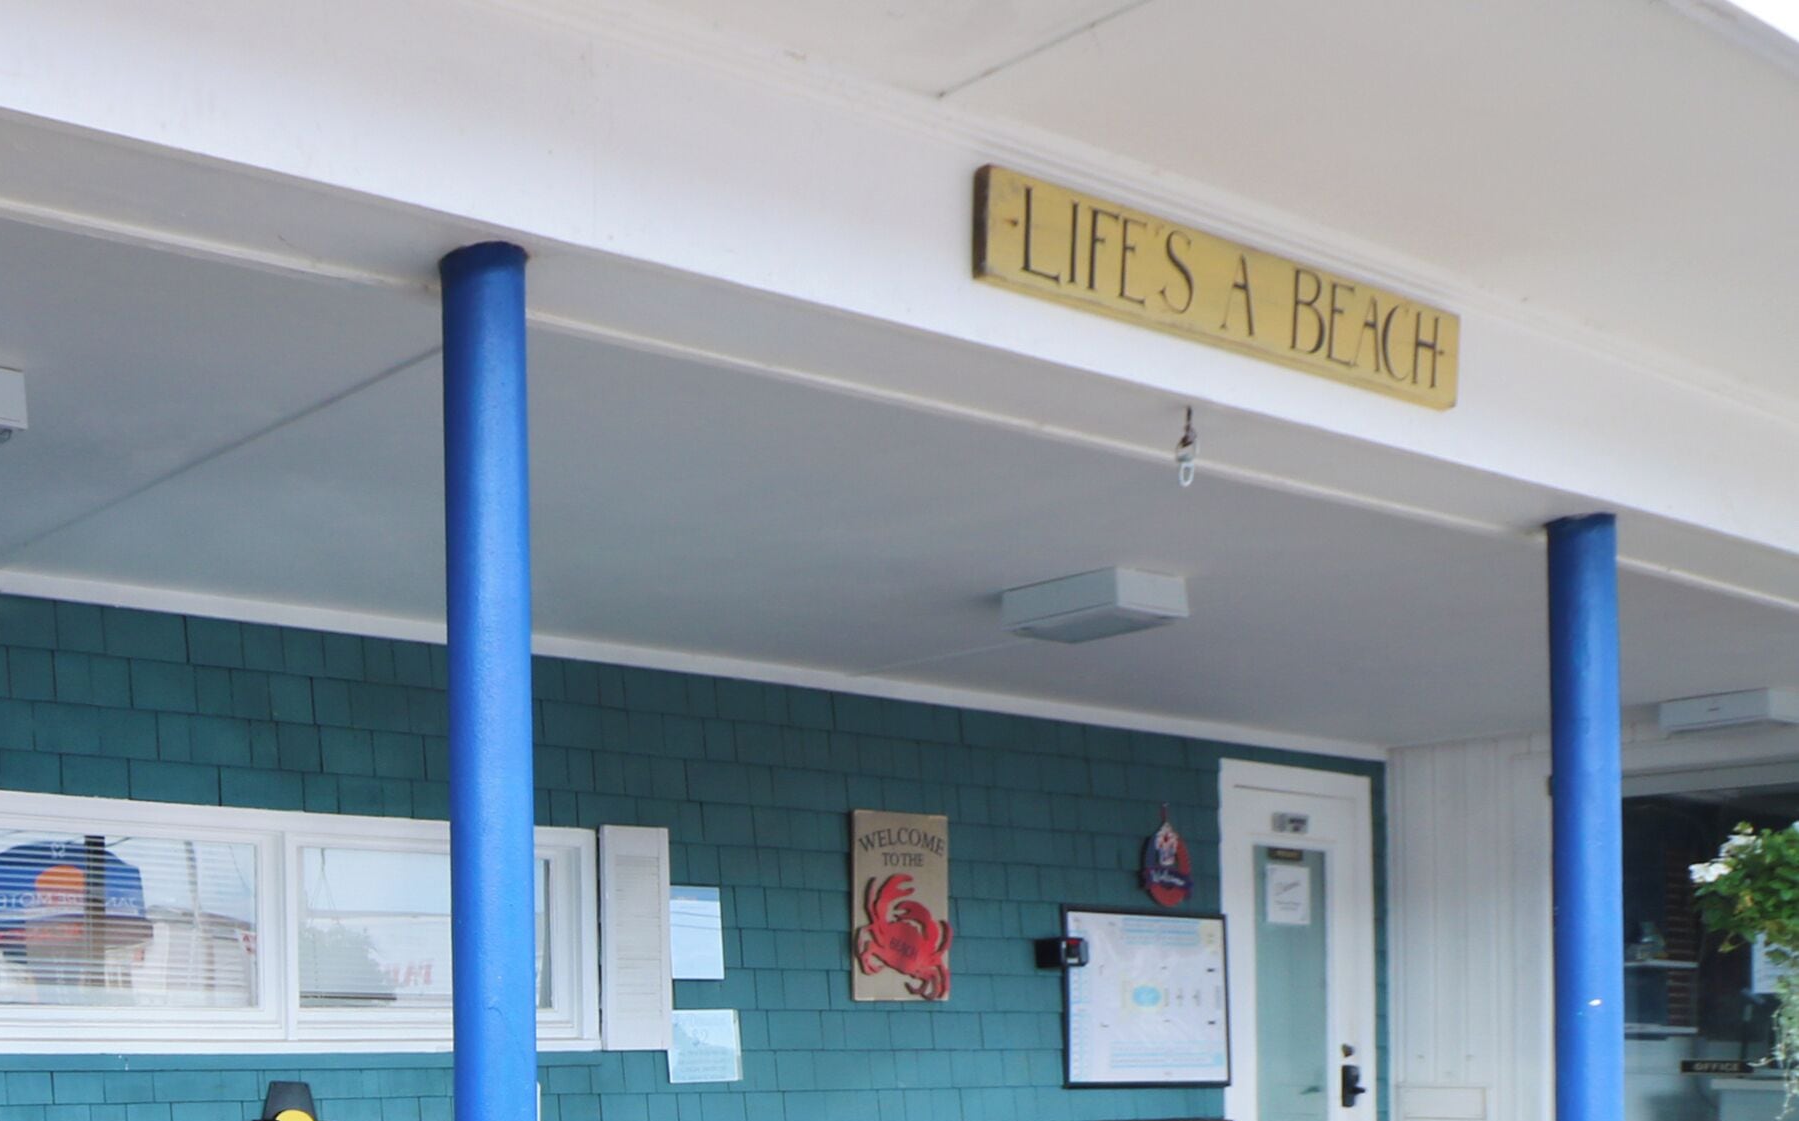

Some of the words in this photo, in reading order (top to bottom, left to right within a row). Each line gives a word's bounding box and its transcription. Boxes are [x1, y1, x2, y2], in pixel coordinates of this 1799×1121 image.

[1021, 185, 1194, 315] LIFE'S
[1219, 254, 1255, 337] A
[1290, 267, 1442, 388] BEACH
[858, 827, 945, 857] WELCOME
[882, 852, 900, 867] TO
[901, 853, 924, 867] THE
[1693, 1062, 1739, 1072] OFFICE
